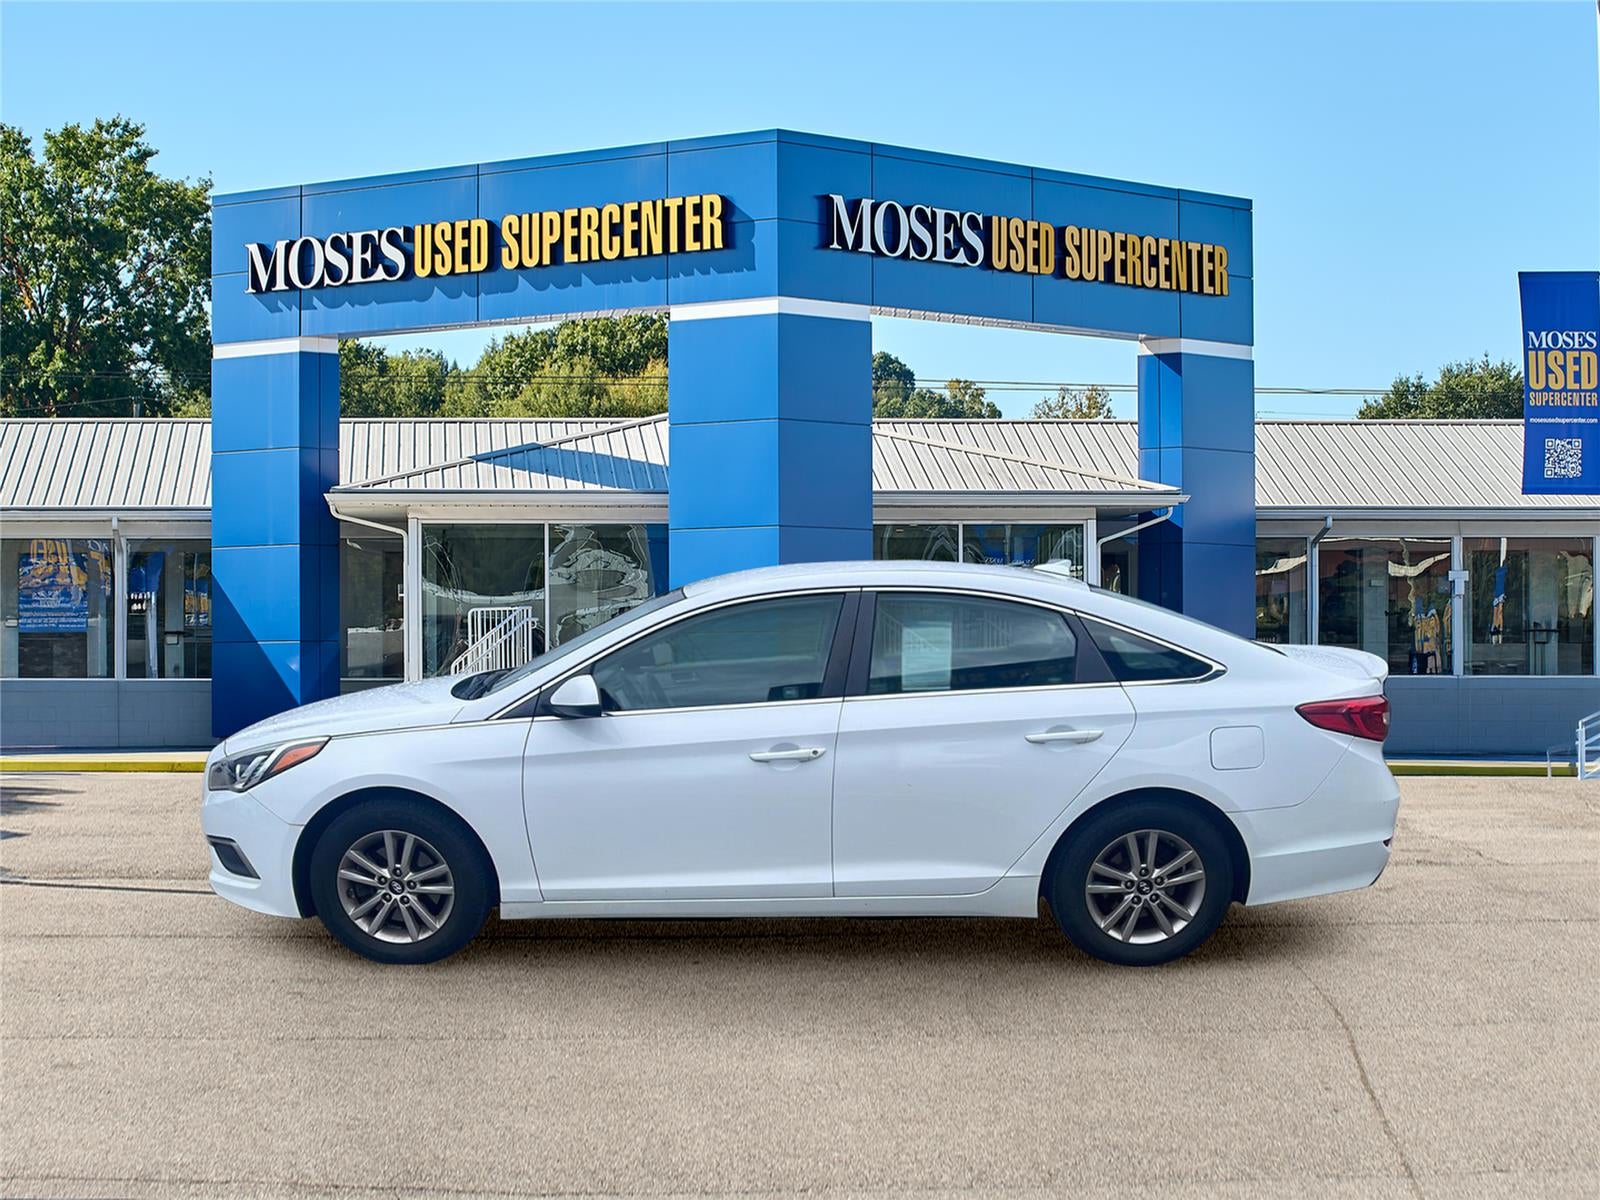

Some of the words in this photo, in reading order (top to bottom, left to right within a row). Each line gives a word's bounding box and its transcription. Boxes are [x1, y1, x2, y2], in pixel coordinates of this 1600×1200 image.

[244, 227, 406, 294] MOSES
[414, 218, 489, 279] USED
[500, 193, 724, 270] SUPERCENTER
[829, 194, 985, 268] MOSES
[991, 215, 1056, 275] USED
[1065, 225, 1230, 296] SUPERCENTER
[1528, 331, 1598, 349] MOSES
[1528, 350, 1598, 390] USED
[1529, 391, 1599, 407] SUPERCENTER
[1529, 417, 1599, 425] mosesusedsupercenter.com
